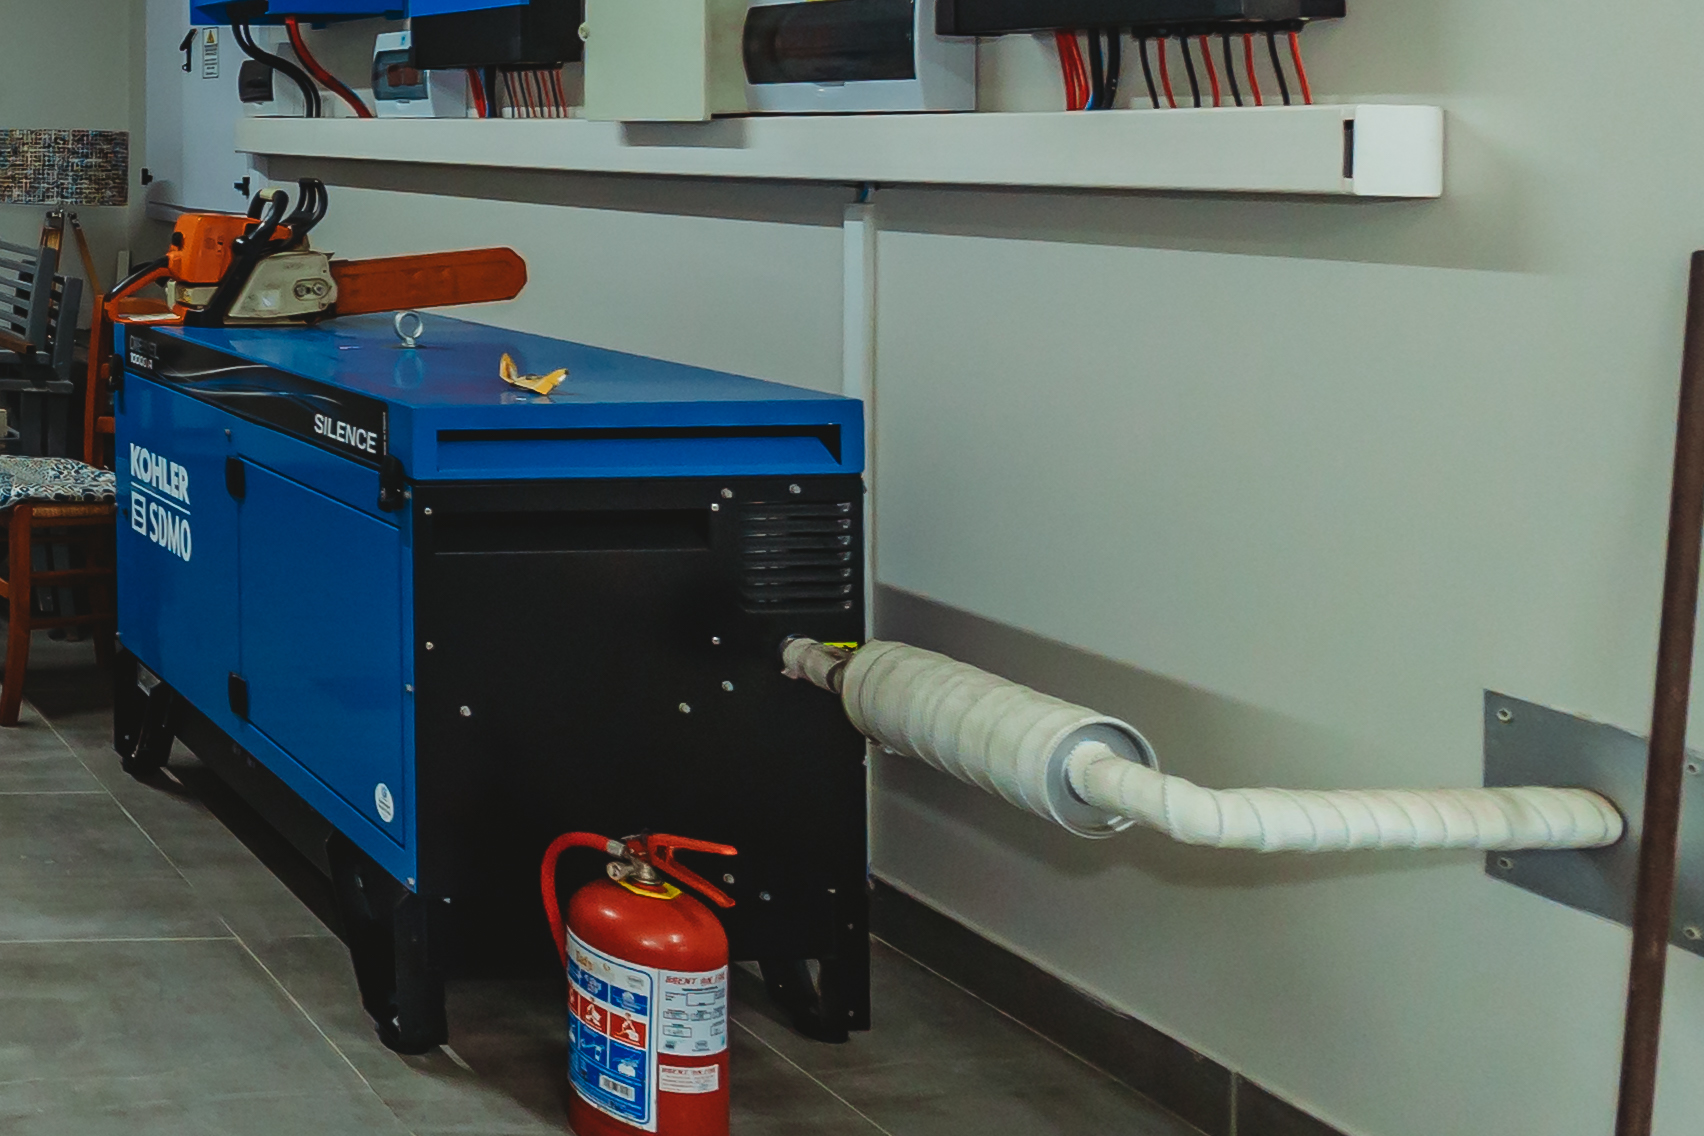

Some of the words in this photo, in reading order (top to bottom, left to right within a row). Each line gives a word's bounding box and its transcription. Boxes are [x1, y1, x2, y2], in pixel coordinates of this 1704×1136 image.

[313, 413, 378, 454] SILENCE
[129, 442, 191, 506] KOHLER
[148, 501, 192, 562] SDMO
